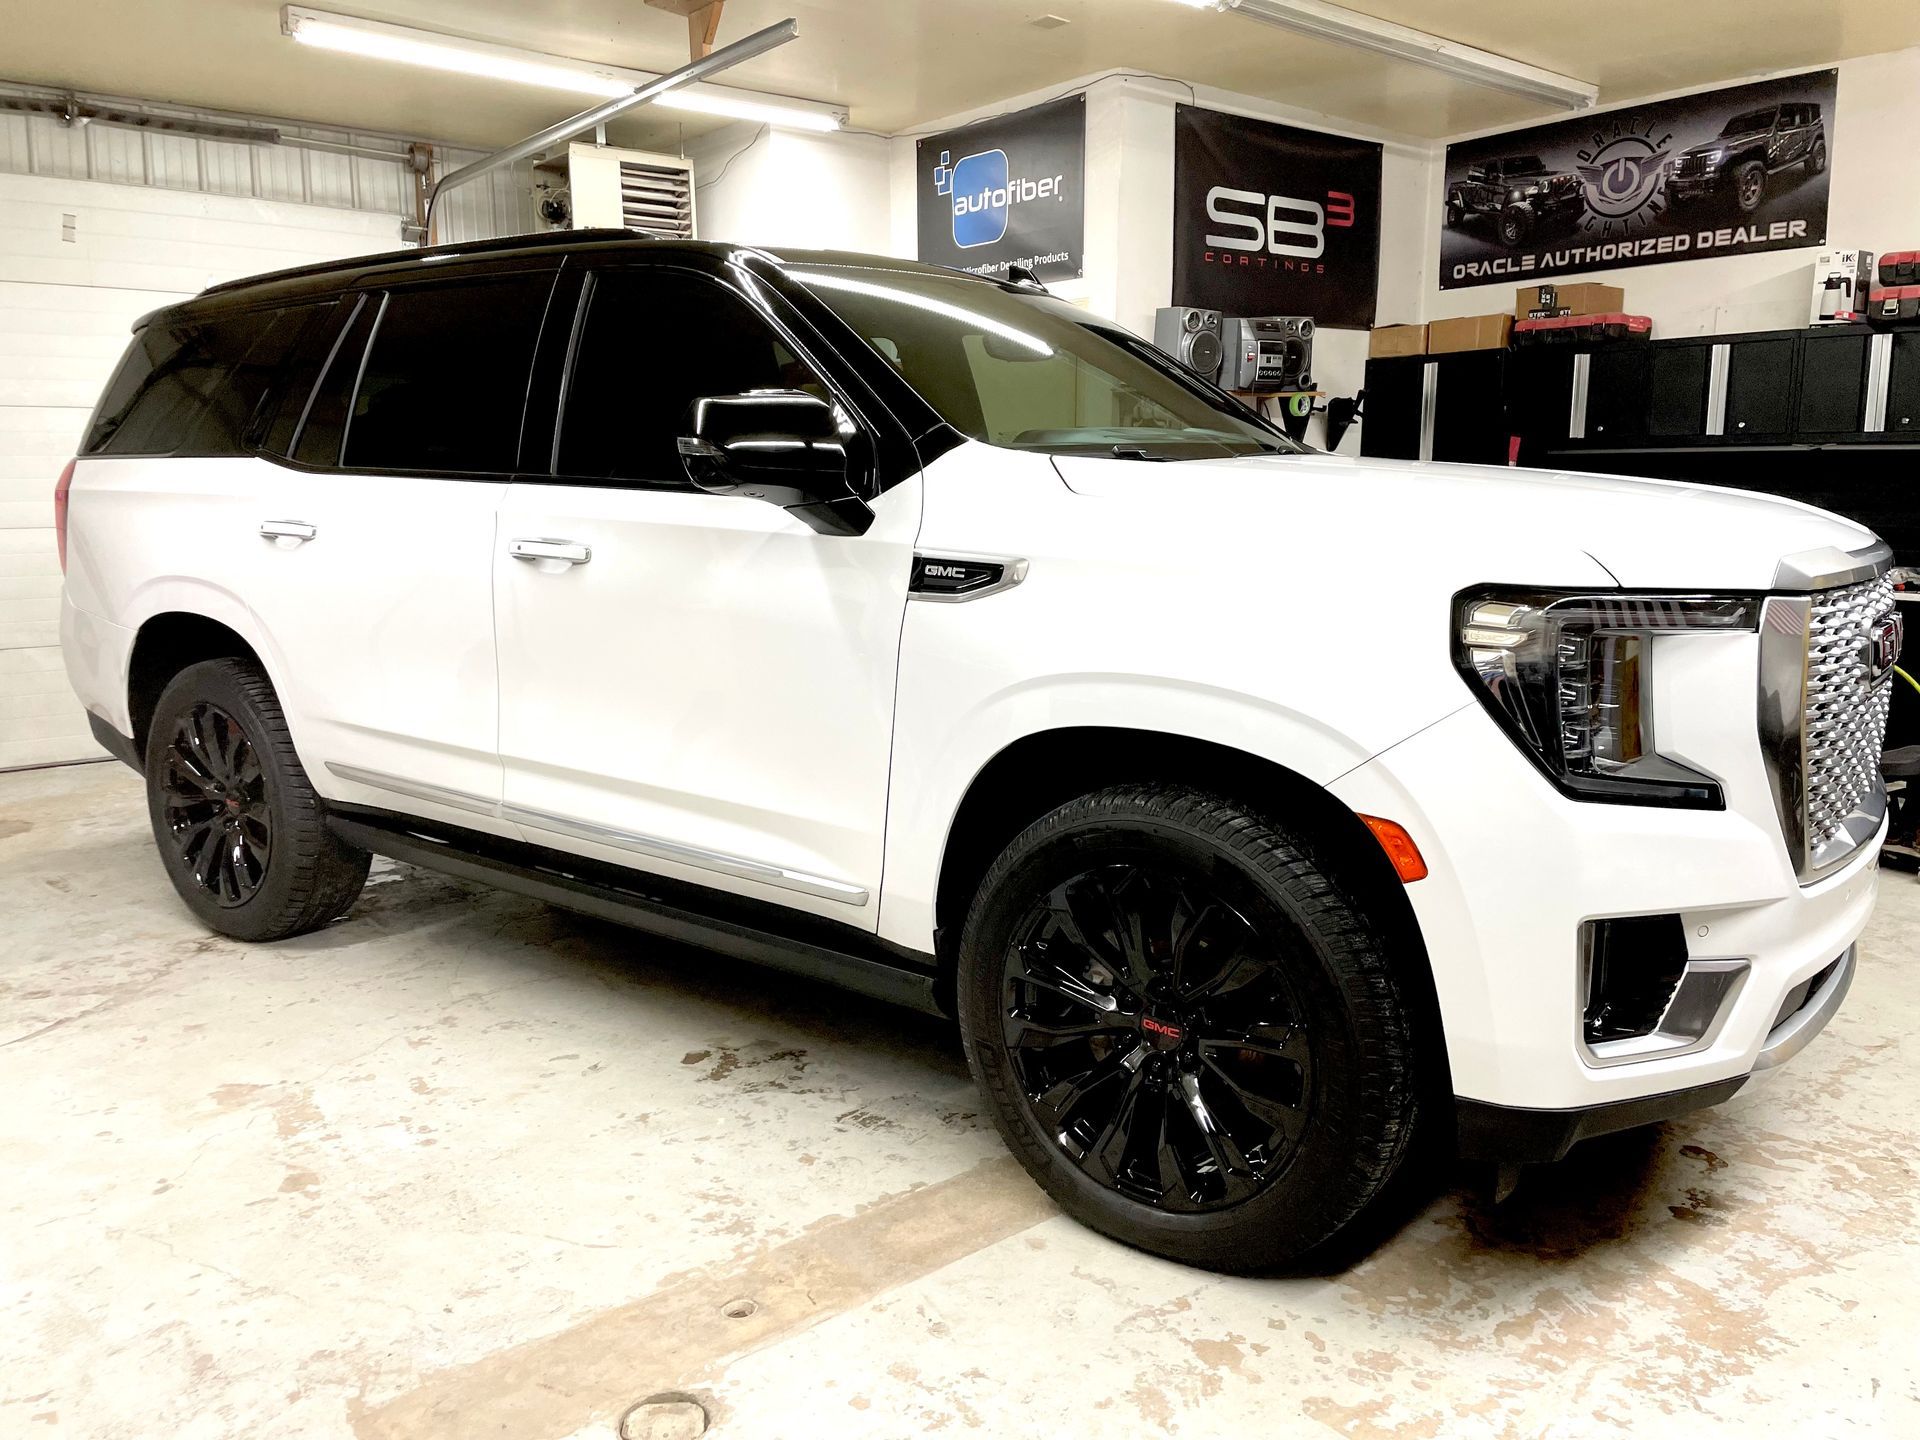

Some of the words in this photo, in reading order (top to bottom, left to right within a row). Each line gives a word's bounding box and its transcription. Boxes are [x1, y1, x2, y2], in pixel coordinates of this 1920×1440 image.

[954, 175, 1063, 216] autofiber
[1034, 252, 1069, 265] Products
[1453, 254, 1536, 279] ORACLE
[1540, 234, 1691, 269] AUTHORIZED
[1696, 219, 1807, 249] DEALER
[1204, 252, 1325, 274] COATINGS
[924, 564, 966, 578] GMC
[1143, 1018, 1180, 1038] GMC
